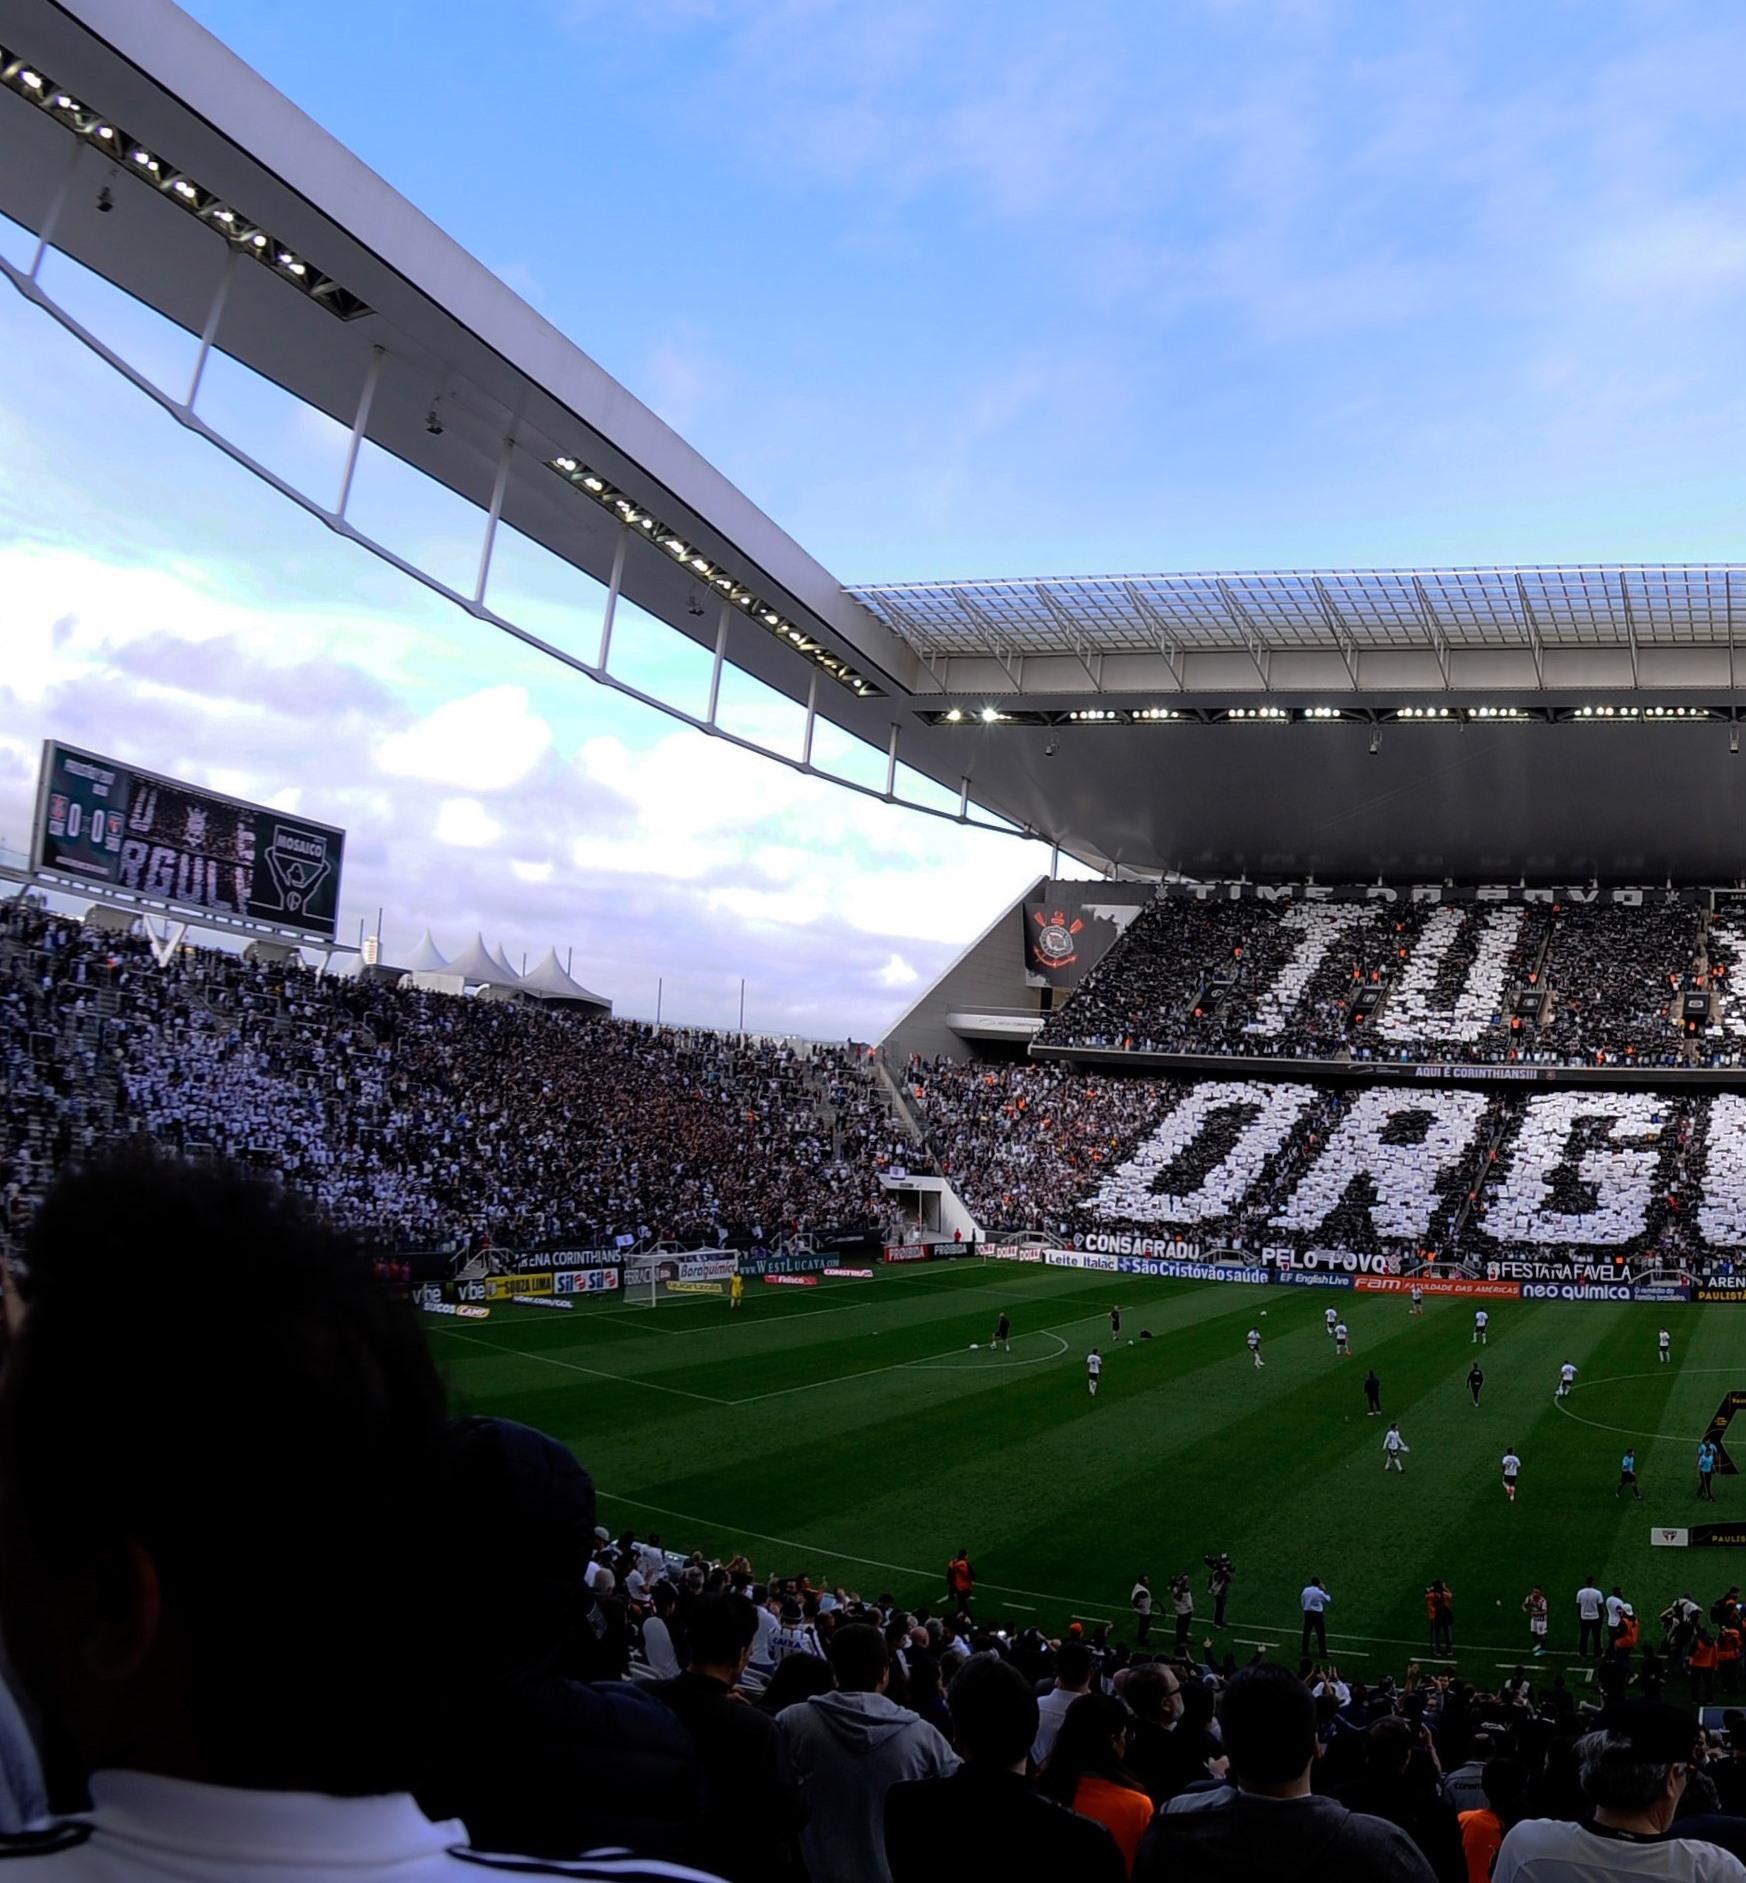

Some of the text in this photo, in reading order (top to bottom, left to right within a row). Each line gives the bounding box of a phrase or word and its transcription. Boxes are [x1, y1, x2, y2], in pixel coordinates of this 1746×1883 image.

[67, 802, 82, 838] 0
[91, 809, 105, 843] 0
[1415, 1066, 1442, 1078] AQUI
[551, 1248, 622, 1267] CORINTHIANS
[1048, 1251, 1115, 1270] Leite Italac
[1262, 1247, 1318, 1272] PELO
[1131, 1258, 1269, 1285] São Cristóvão saúde
[1279, 1272, 1349, 1286] EF English Live
[557, 1276, 572, 1292] Sil
[588, 1272, 603, 1290] Sil
[1455, 1285, 1473, 1293] DAS
[1474, 1284, 1520, 1295] AMÉRICAS
[1523, 1284, 1631, 1300] neo química
[772, 1636, 802, 1649] CAIXA
